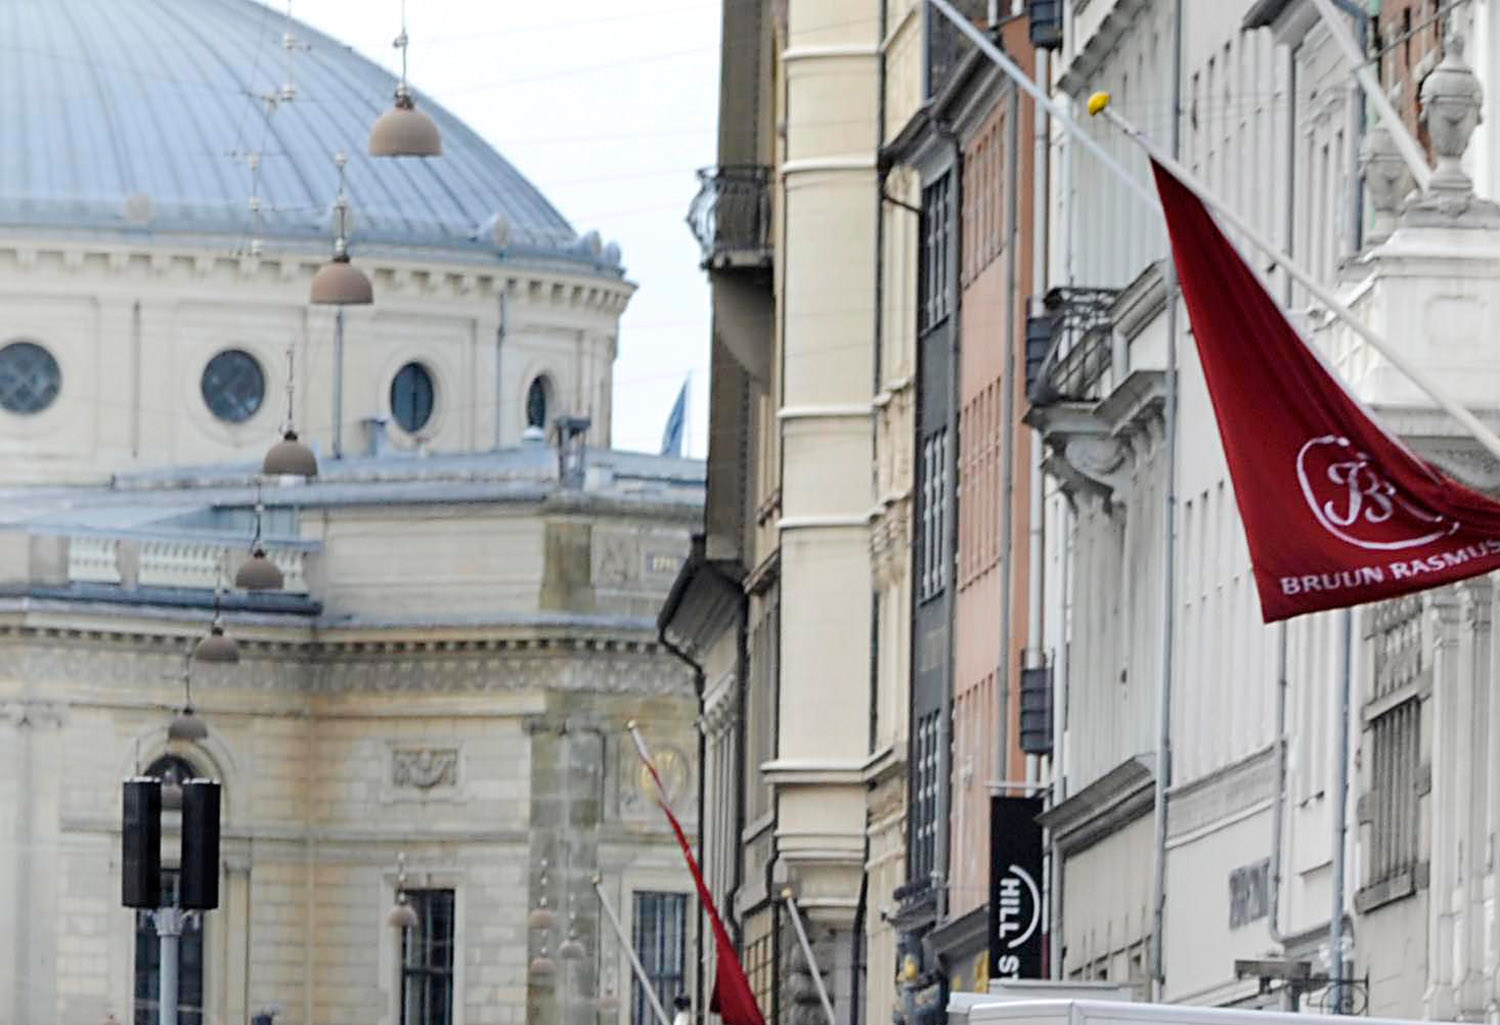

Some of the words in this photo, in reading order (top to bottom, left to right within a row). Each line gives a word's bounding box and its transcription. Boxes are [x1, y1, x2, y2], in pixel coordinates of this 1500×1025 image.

[1280, 566, 1385, 596] BRUUN
[999, 878, 1021, 939] HILL
[998, 955, 1020, 981] S
